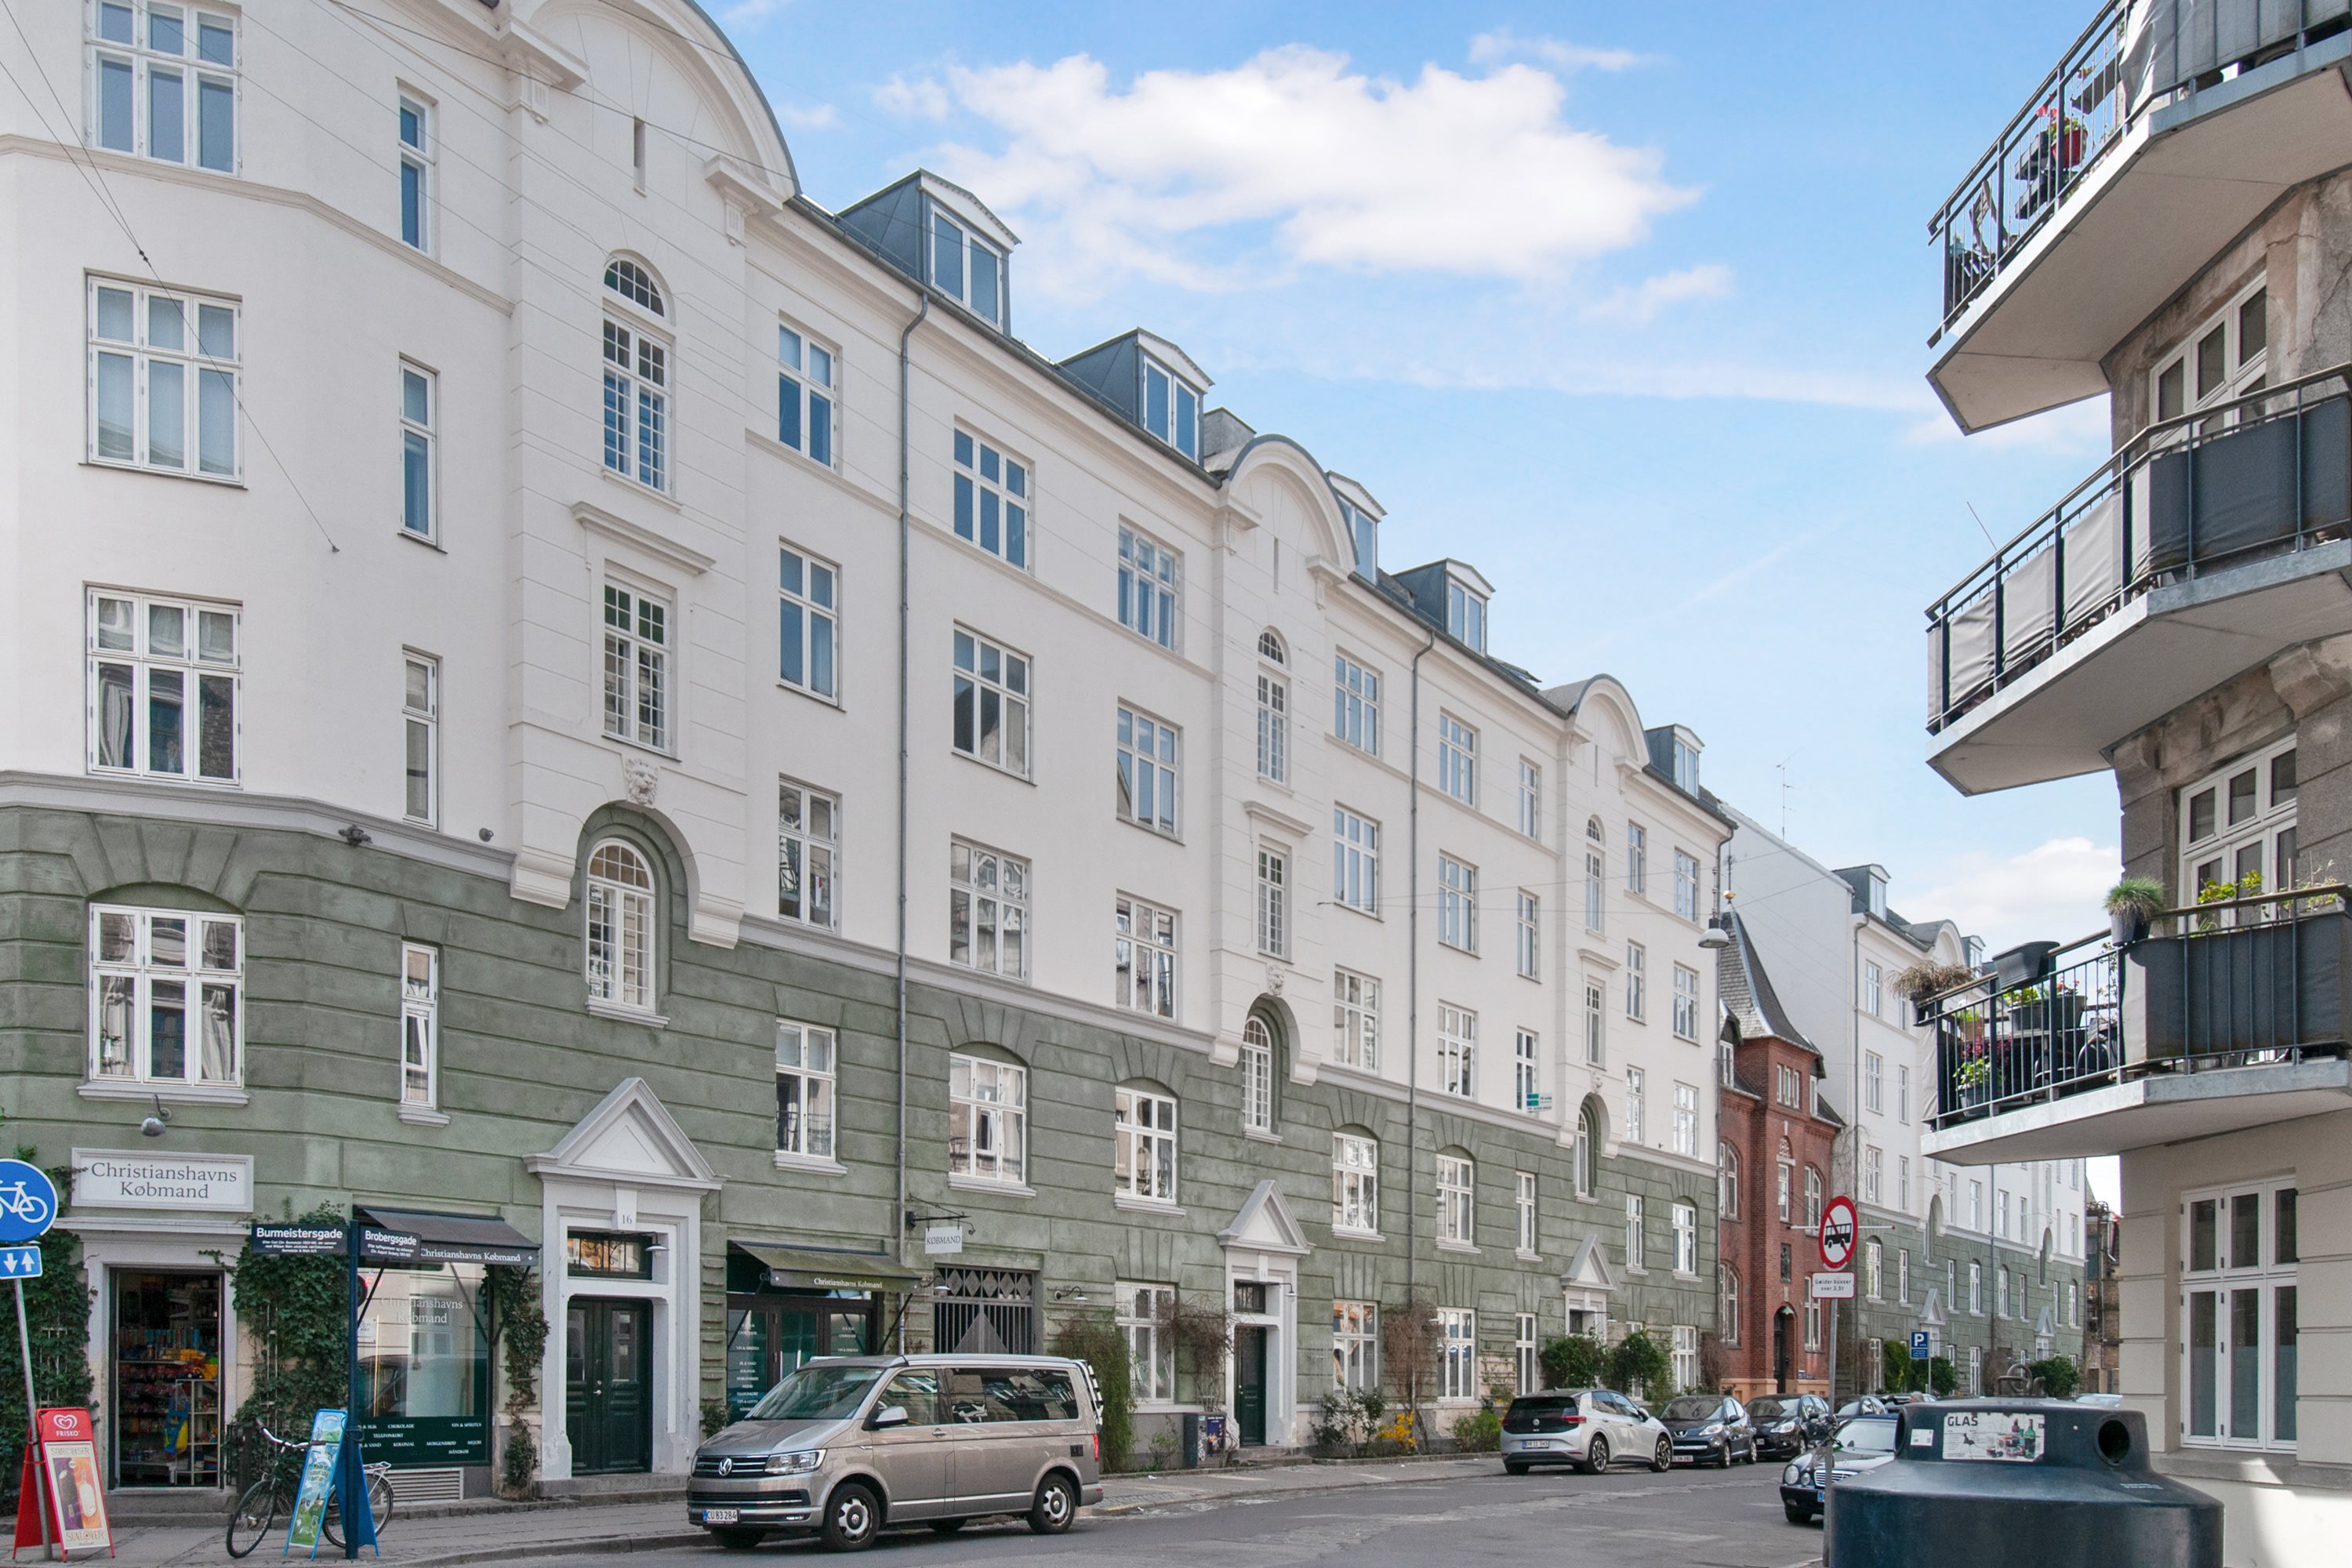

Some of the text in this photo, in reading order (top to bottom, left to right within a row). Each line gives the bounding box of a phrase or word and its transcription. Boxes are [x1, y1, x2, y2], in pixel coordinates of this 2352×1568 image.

[91, 1162, 238, 1182] Christianshavns
[120, 1181, 209, 1199] Købmand
[622, 1214, 633, 1224] 16
[256, 1227, 343, 1240] Burmeistersgade
[365, 1230, 417, 1246] Brobergsgade
[927, 1236, 961, 1245] KØBMAND
[420, 1247, 482, 1260] Christianshavns
[484, 1252, 521, 1262] Købmand
[814, 1277, 856, 1287] Christianshavns
[380, 1296, 463, 1309] Chrisianshavns
[1914, 1333, 1925, 1347] P
[1947, 1415, 1979, 1427] GLAS
[707, 1511, 737, 1519] CU 83 284
